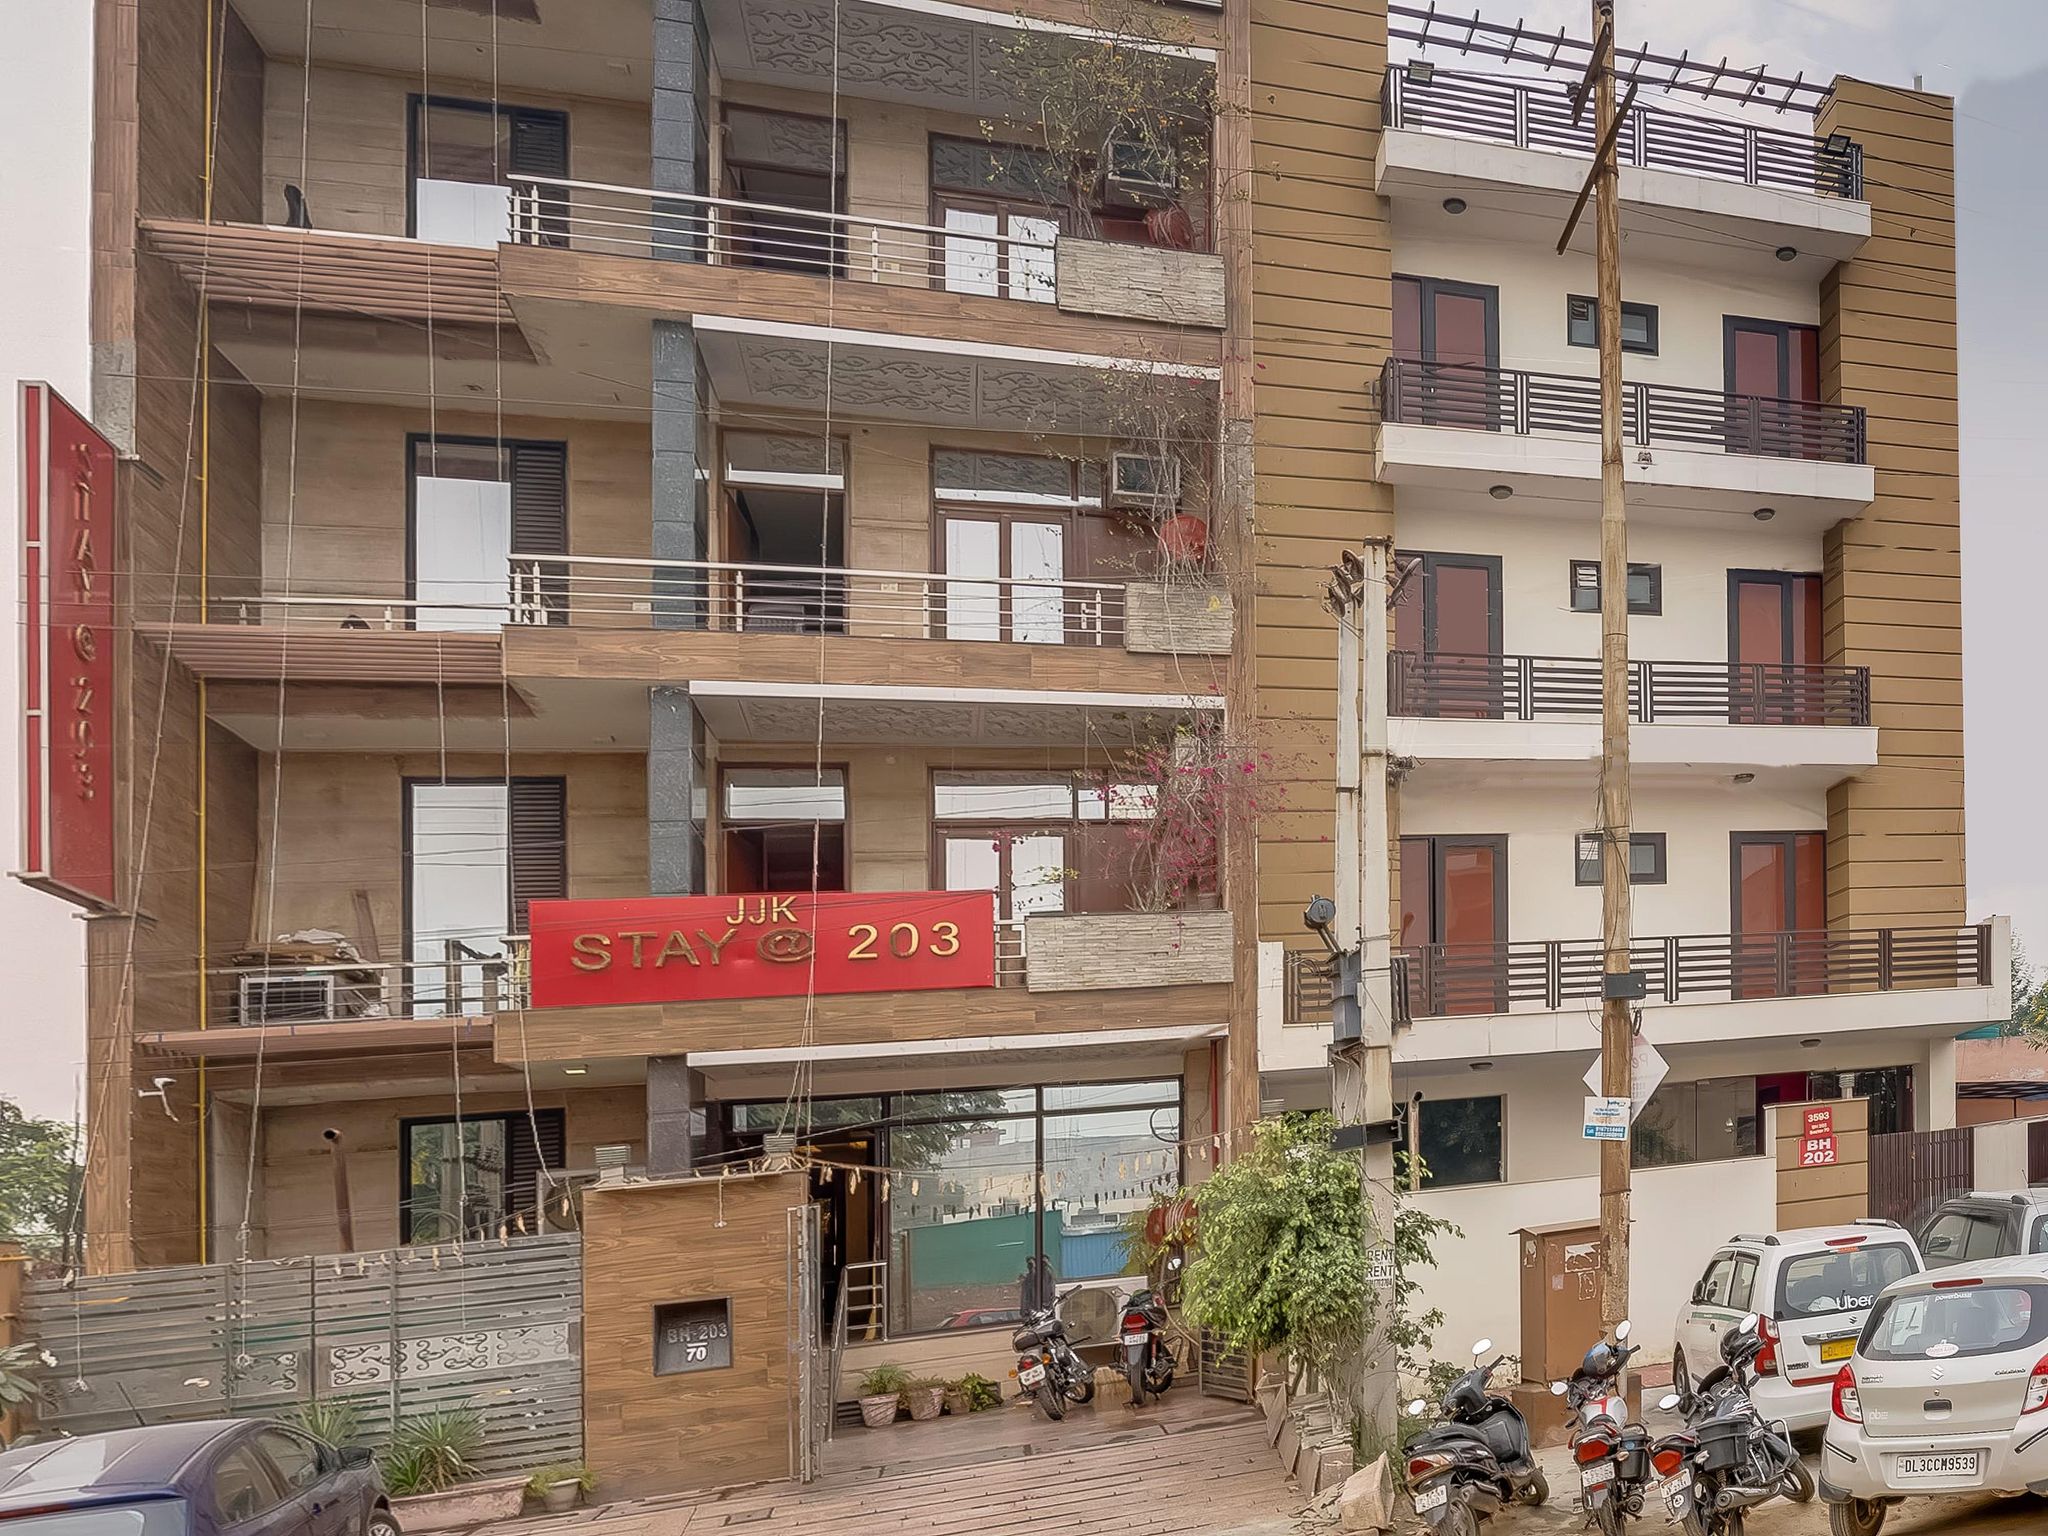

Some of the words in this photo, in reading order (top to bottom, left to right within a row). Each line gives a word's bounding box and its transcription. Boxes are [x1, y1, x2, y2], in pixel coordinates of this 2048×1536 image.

[726, 895, 798, 925] JJK
[571, 928, 739, 971] STAY
[756, 927, 816, 963] @
[847, 921, 961, 961] 203
[1807, 1111, 1830, 1123] 3593
[1807, 1137, 1831, 1151] BH
[1803, 1150, 1835, 1165] 202
[1367, 1248, 1394, 1262] RENT
[1366, 1264, 1394, 1278] RENT
[1835, 1293, 1874, 1311] Uber
[667, 1322, 728, 1344] BH-203
[686, 1346, 707, 1362] 70
[1905, 1456, 1976, 1473] DL3CCM9539
